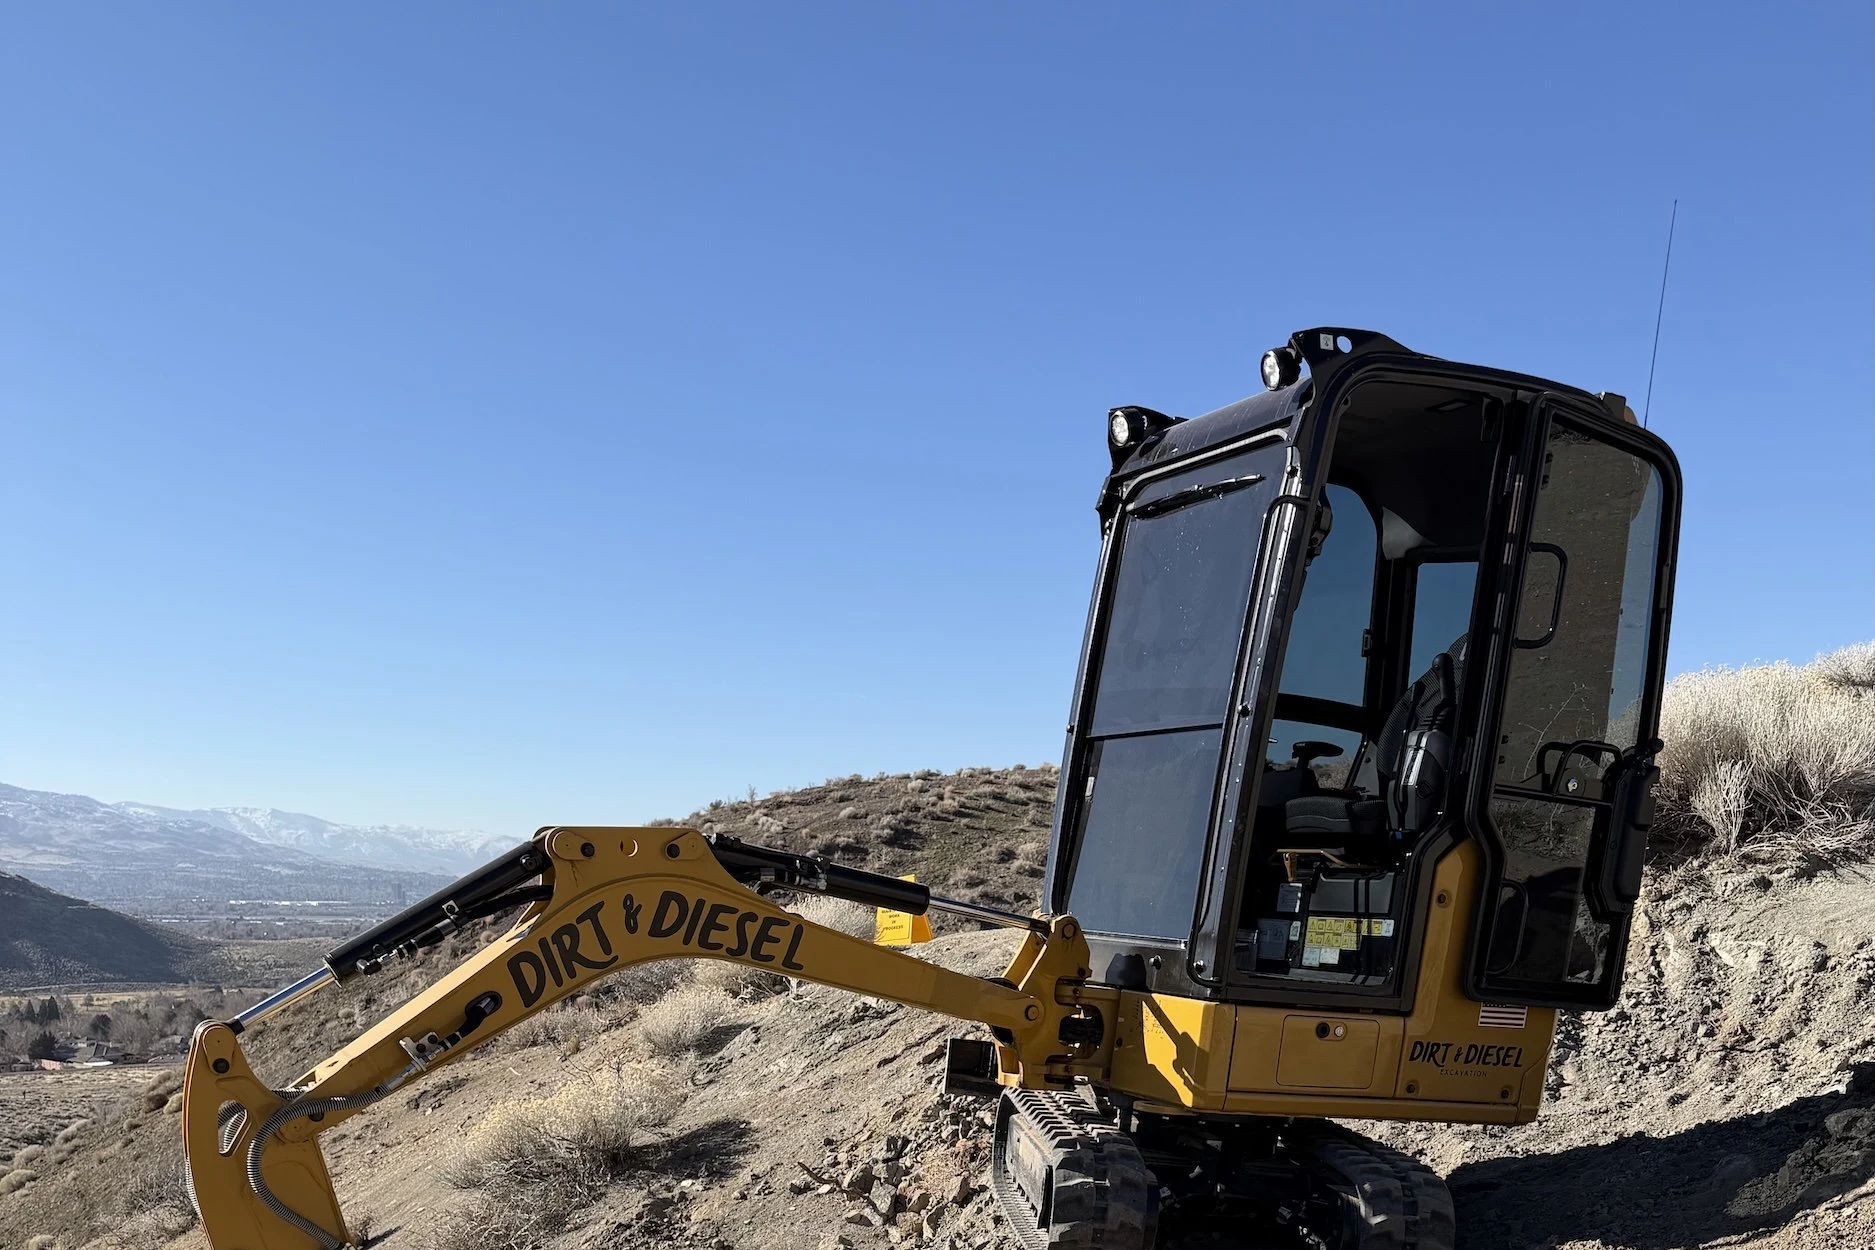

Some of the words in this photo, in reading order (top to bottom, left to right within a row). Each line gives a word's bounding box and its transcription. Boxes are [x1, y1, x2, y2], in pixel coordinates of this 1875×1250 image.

[506, 901, 619, 1008] DIRT
[622, 893, 643, 934] &
[648, 890, 804, 971] DIESEL
[1409, 1041, 1453, 1067] DIRT
[1454, 1046, 1463, 1063] &
[1464, 1044, 1522, 1067] DIESEL
[1440, 1069, 1487, 1078] EXCAVATION
